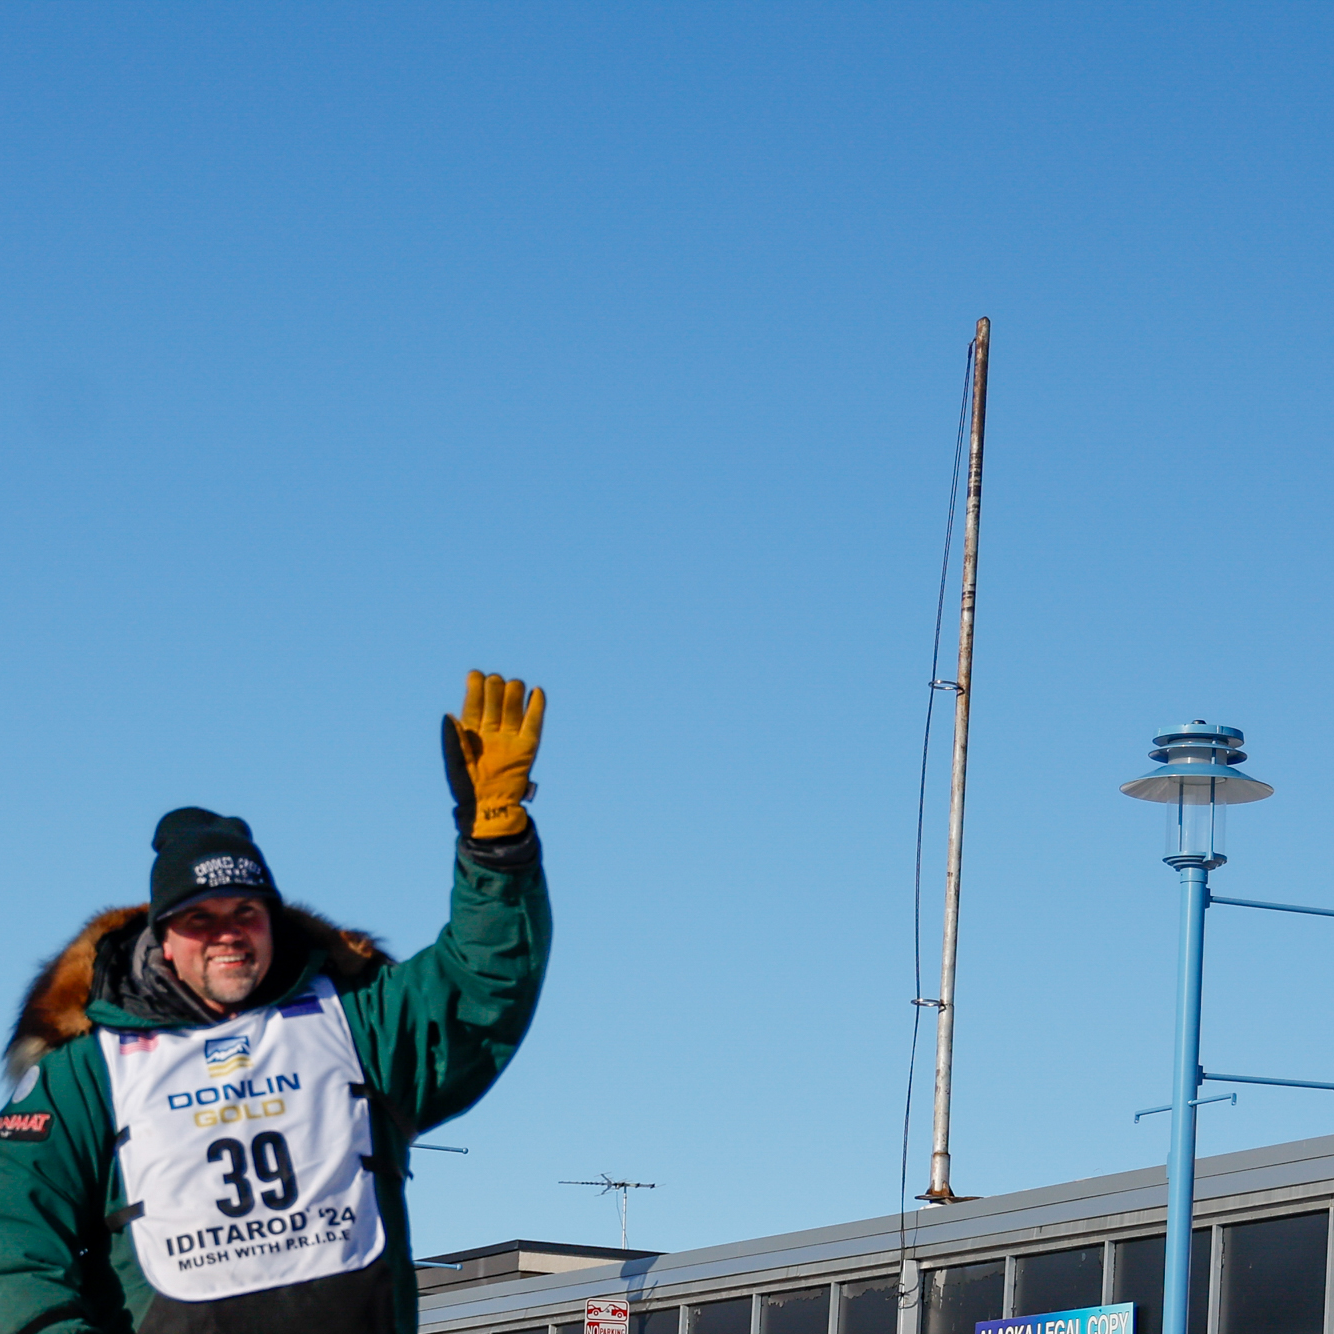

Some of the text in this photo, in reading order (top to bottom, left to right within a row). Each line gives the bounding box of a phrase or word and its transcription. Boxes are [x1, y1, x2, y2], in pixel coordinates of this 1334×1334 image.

[168, 1072, 302, 1110] DONLIN
[193, 1098, 286, 1128] GOLD
[206, 1130, 299, 1218] 39
[166, 1212, 309, 1257] IDITAROD
[178, 1250, 230, 1272] MUSH
[235, 1242, 281, 1259] WITH
